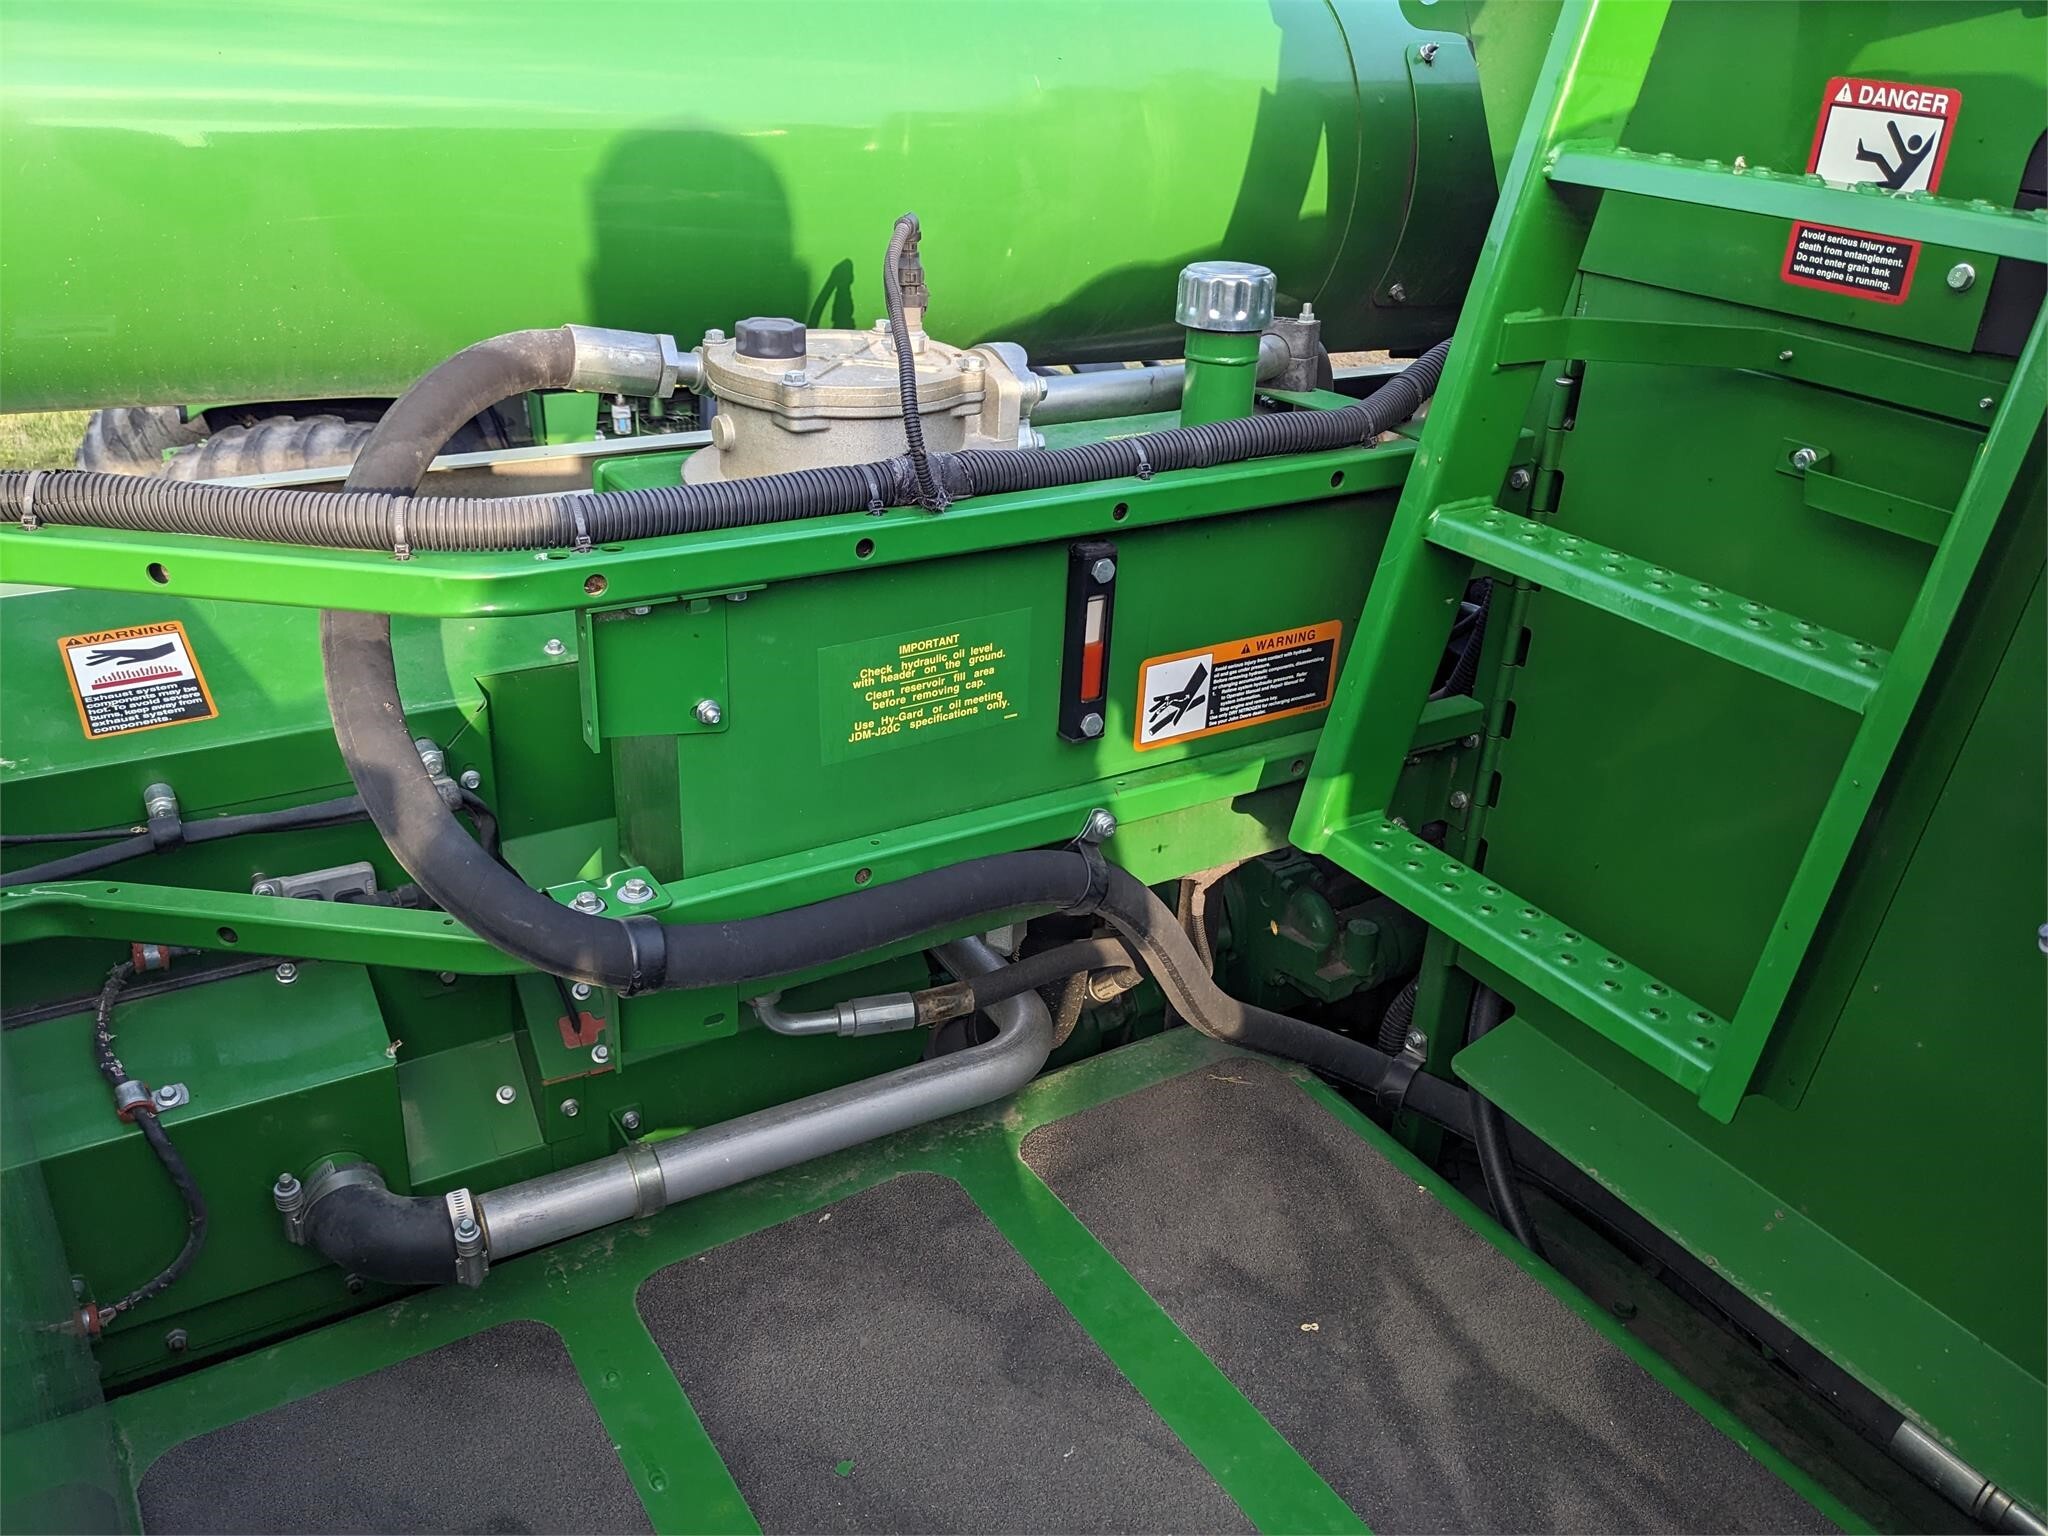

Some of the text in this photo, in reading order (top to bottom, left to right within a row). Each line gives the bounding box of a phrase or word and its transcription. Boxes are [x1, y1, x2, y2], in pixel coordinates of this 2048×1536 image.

[1858, 85, 1949, 114] DANGER
[1801, 229, 1897, 254] Avoid serious injury or
[1796, 251, 1891, 277] Do not enter grain tank
[1798, 241, 1904, 268] death from entanglement.
[1793, 264, 1890, 290] when engine is running.
[83, 623, 178, 644] WARNING
[899, 634, 959, 654] IMPORTANT
[1256, 629, 1316, 651] WARNING
[853, 649, 1005, 689] with header on the ground.
[860, 643, 993, 678] Check hydraulic oil level
[85, 683, 178, 703] Exhaust system
[865, 667, 994, 701] Clean reservoir fill area
[873, 679, 986, 710] before removing cap.
[86, 693, 156, 709] components
[158, 689, 181, 697] may
[88, 706, 111, 715] hot.
[129, 698, 160, 709] avoid
[163, 692, 200, 702] severe
[90, 697, 203, 721] burns, keep away from
[854, 691, 1003, 731] Use Hy-Gard or oil meeting
[91, 707, 185, 727] exhaust system
[93, 716, 172, 733] components.
[848, 699, 1010, 743] JDM-J20C specifications only.
